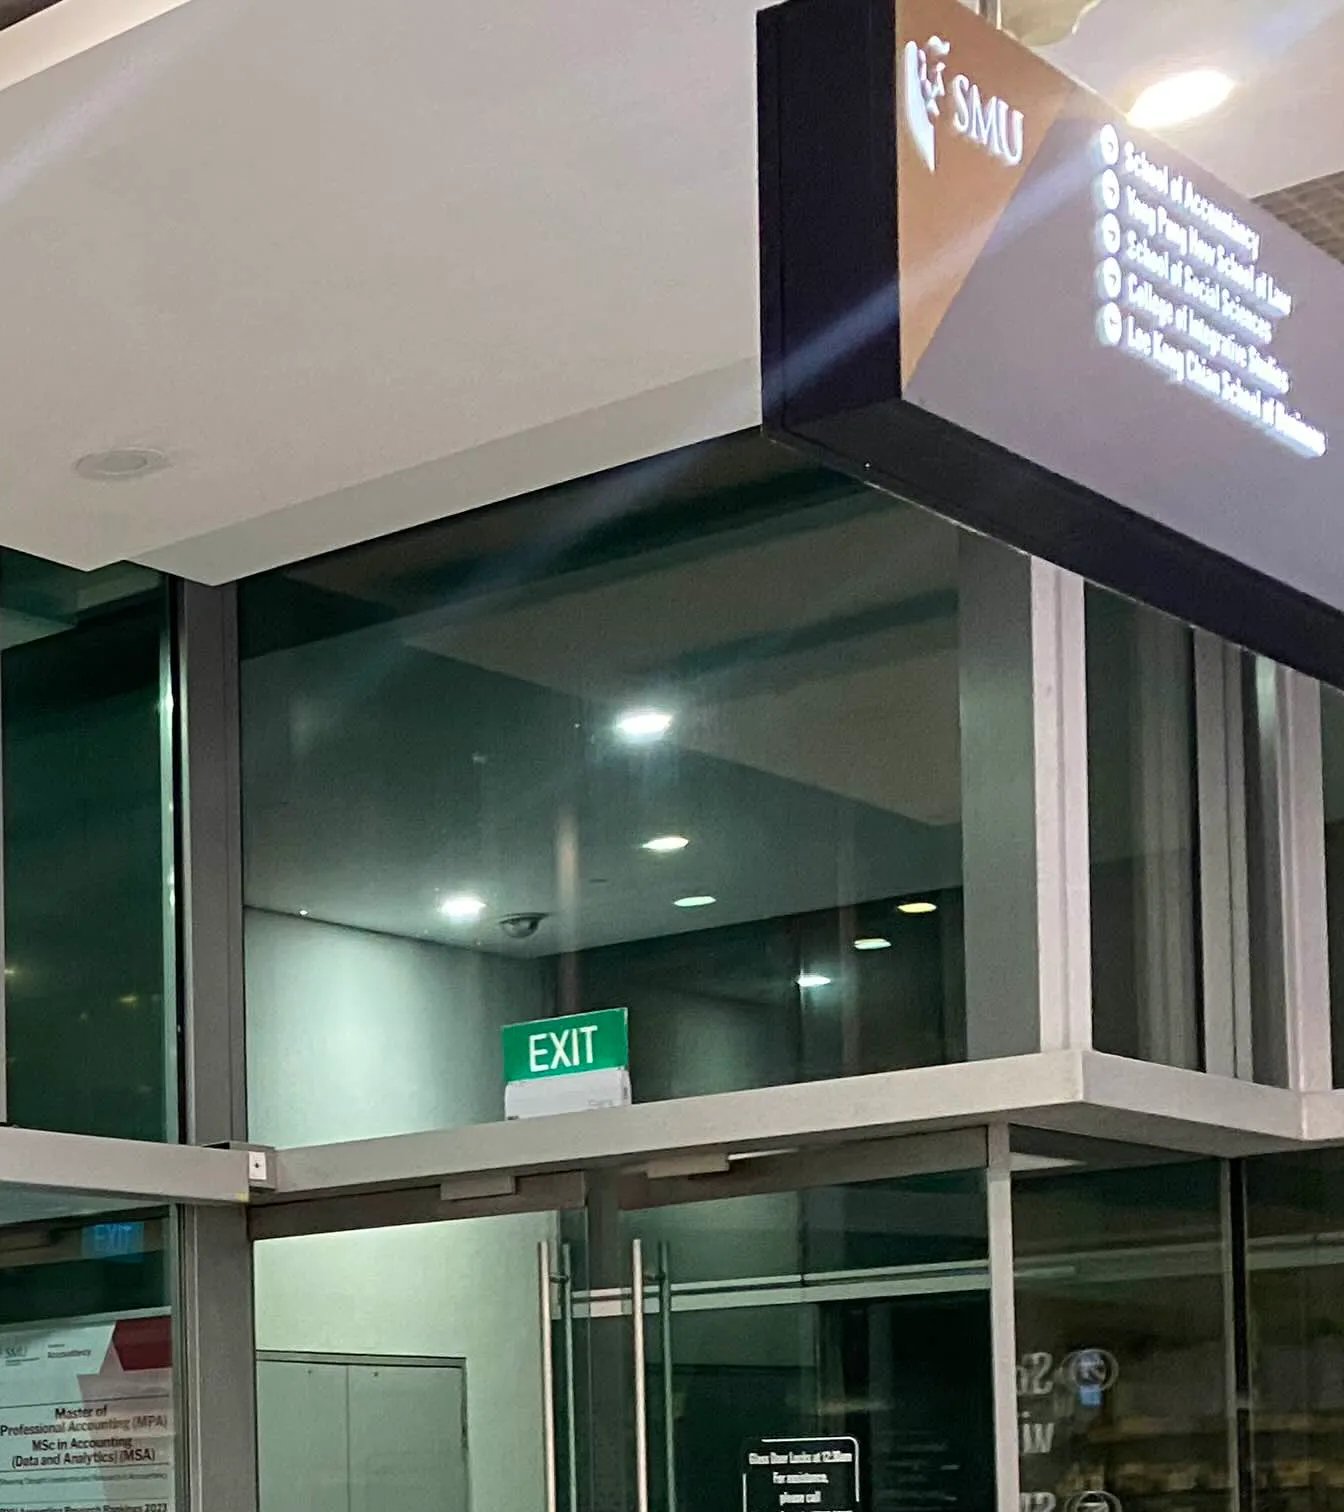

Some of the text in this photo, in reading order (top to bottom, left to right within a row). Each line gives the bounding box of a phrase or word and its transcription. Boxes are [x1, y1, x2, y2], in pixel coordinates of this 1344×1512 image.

[952, 74, 1024, 165] SMU
[1124, 141, 1168, 195] School
[1170, 176, 1183, 203] of
[1128, 230, 1169, 278] School
[1170, 260, 1183, 288] of
[1184, 265, 1220, 312] Social
[1216, 244, 1255, 292] School
[529, 1025, 598, 1072] EXIT
[0, 1415, 167, 1436] Professional Accounting (MPA)
[55, 1405, 107, 1419] Master of
[12, 1448, 155, 1469] (Data and Analytics) (MSA)
[32, 1437, 132, 1451] MSc in Accounting
